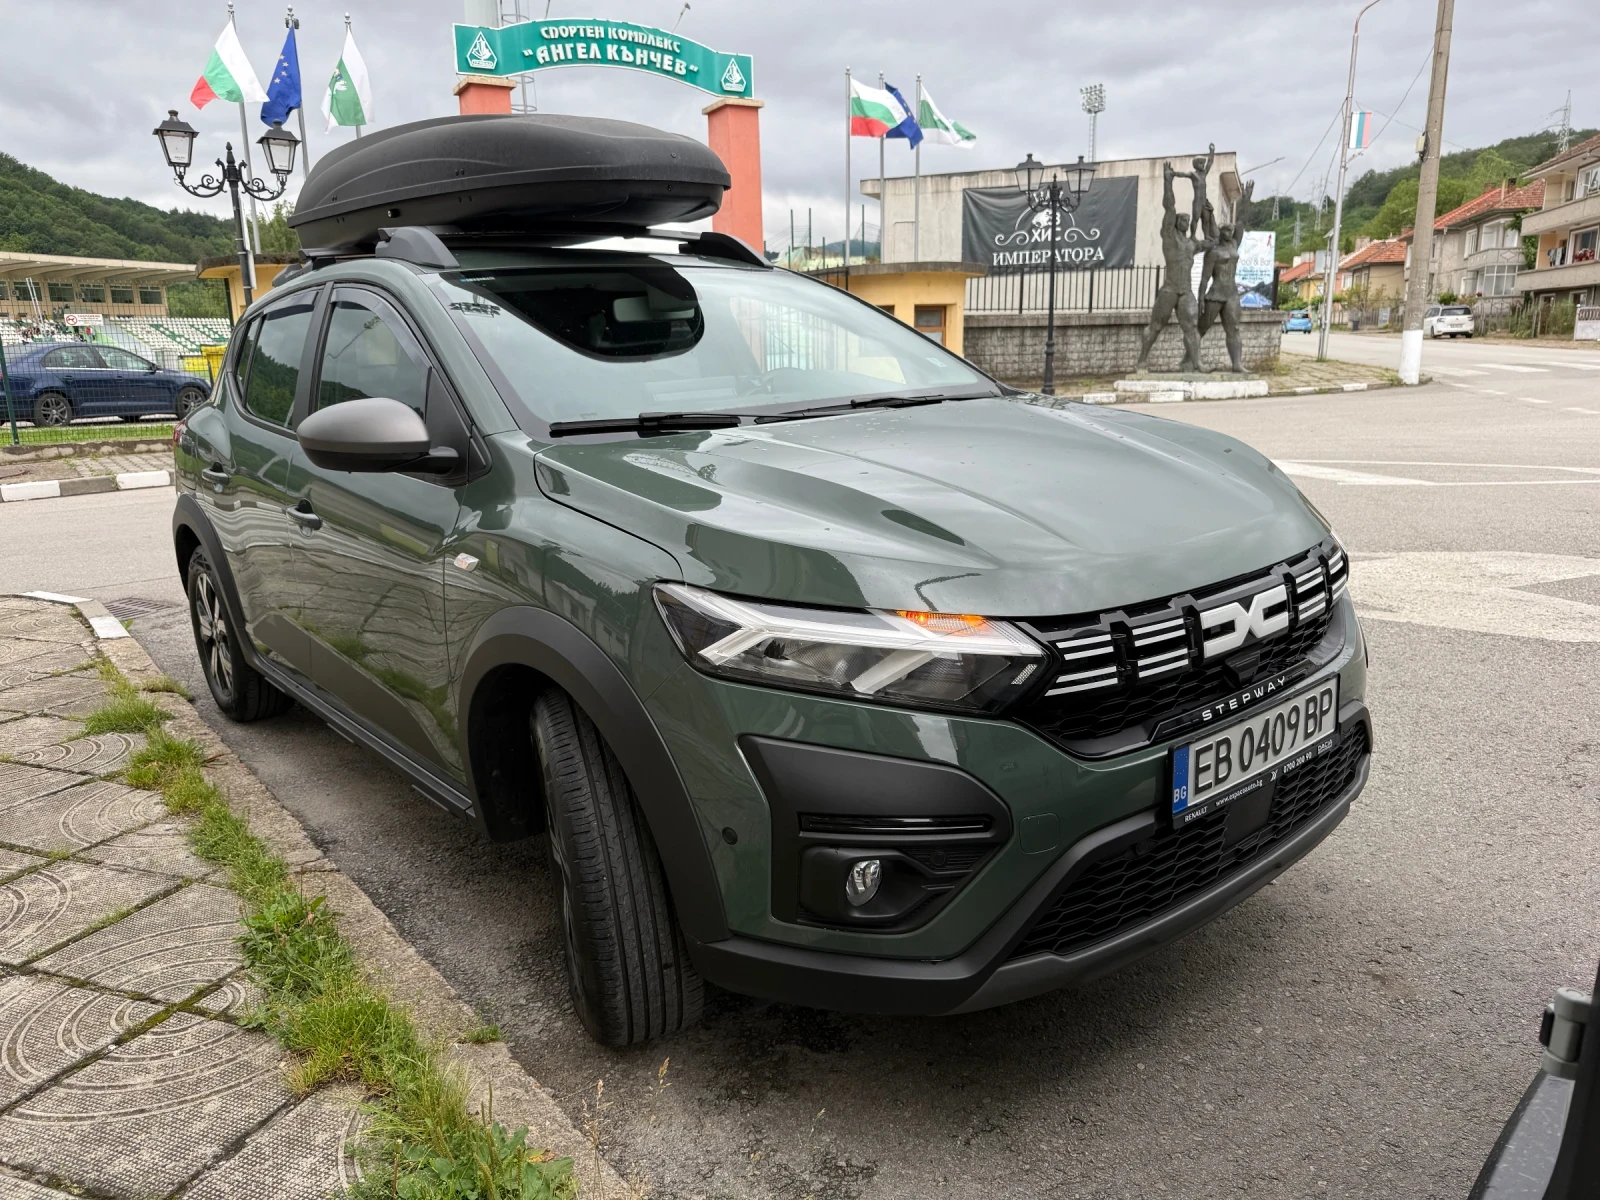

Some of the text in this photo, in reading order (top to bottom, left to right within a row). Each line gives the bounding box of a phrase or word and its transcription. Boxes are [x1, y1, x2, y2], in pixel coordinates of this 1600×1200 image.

[540, 25, 681, 53] СПОРТЕН КОМПЛЕКС
[992, 245, 1105, 266] ИМПЕРАТОРА
[1202, 676, 1285, 721] STEPWAY
[1194, 687, 1333, 797] EB 0409 BP
[1173, 786, 1187, 803] BG
[1184, 806, 1208, 822] RENAULT
